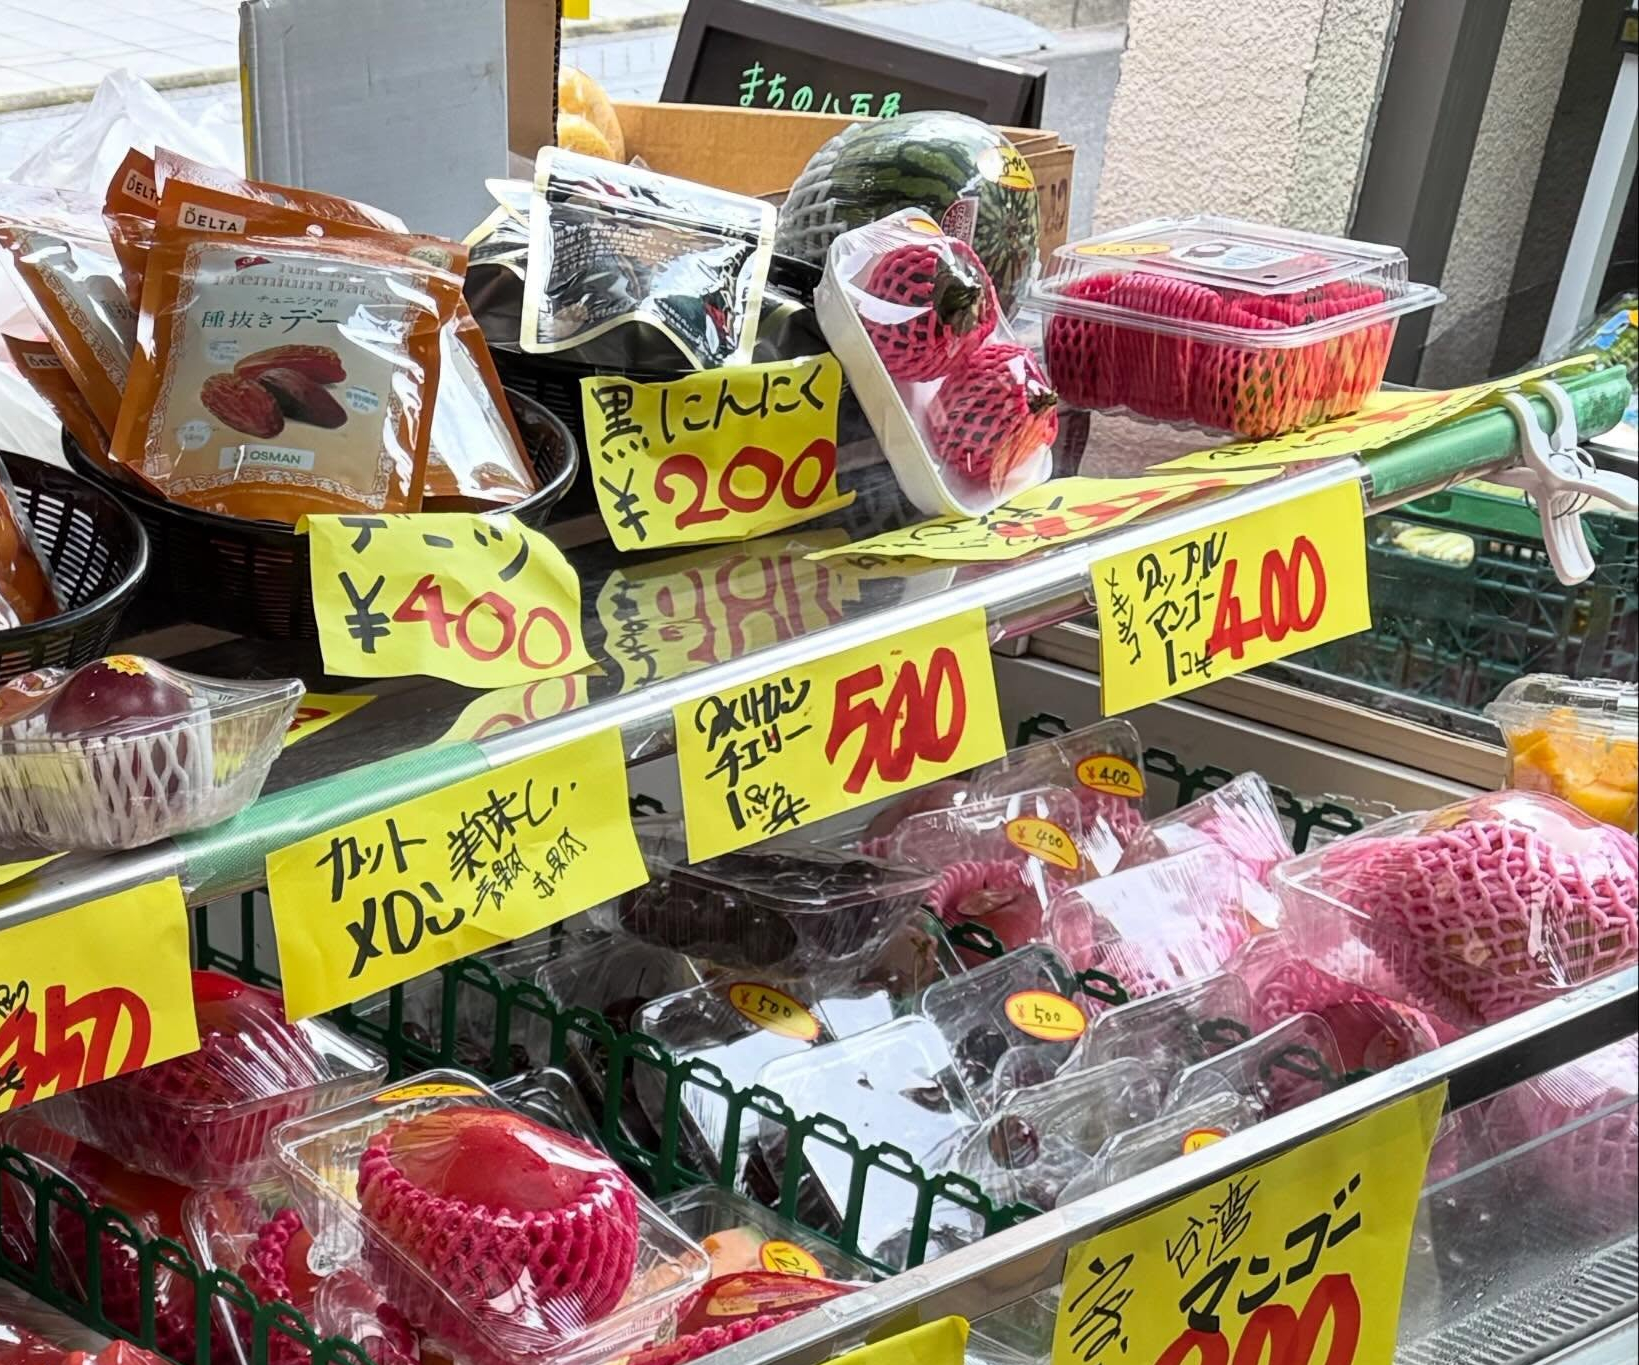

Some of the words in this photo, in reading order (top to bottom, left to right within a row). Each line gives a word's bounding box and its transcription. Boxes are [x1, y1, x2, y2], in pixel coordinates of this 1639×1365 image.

[590, 364, 826, 463] 黒にんにく
[249, 449, 302, 466] OSMAN
[599, 437, 837, 543] ¥200
[339, 514, 530, 583] デーツ
[1136, 531, 1228, 602] アップル
[337, 571, 572, 671] ¥400
[1145, 575, 1215, 640] マンゴー
[705, 722, 813, 789] チェリー
